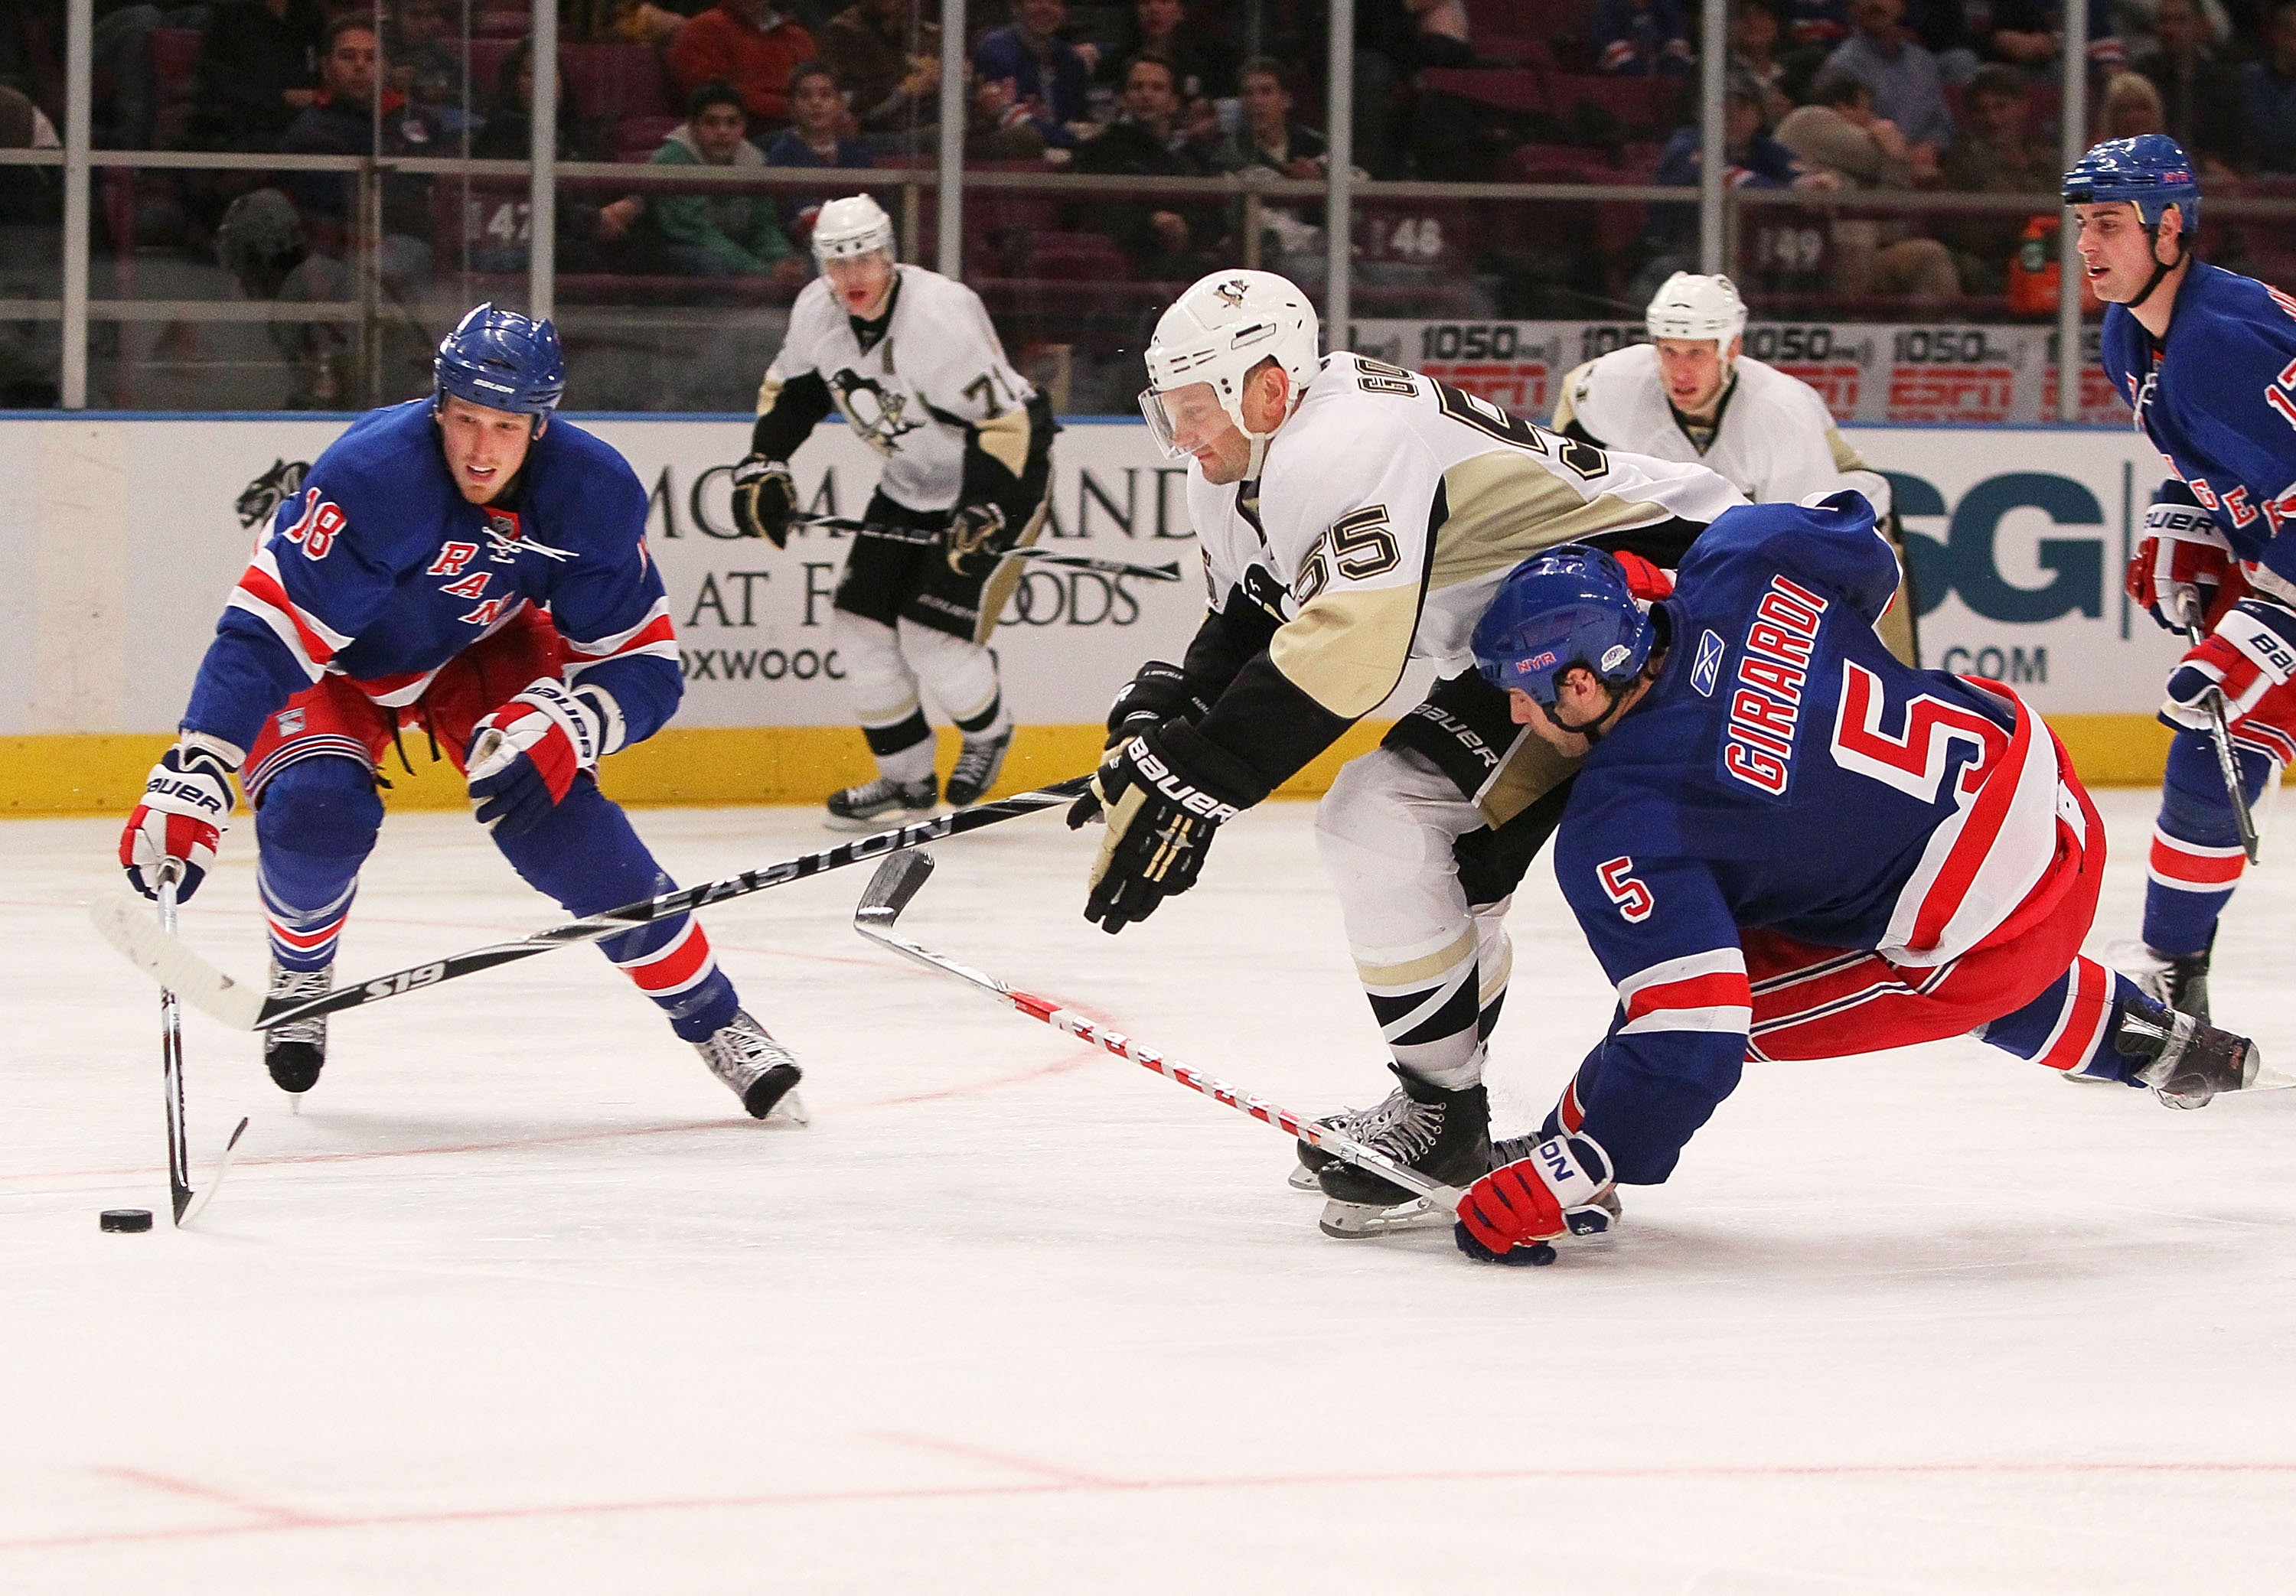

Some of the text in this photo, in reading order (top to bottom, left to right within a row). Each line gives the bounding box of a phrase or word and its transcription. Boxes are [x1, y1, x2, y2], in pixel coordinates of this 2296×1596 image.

[1421, 325, 1518, 360] 1050
[1893, 331, 1986, 362] 1050
[1888, 367, 2013, 407] ESPN
[282, 487, 347, 562] 18
[683, 571, 770, 627] AT
[1515, 651, 1557, 674] NYR
[1724, 574, 1829, 796] GIRARDI
[1411, 703, 1500, 768] BAUER
[1829, 657, 2016, 810] 5
[1127, 735, 1240, 824] BAUER
[652, 813, 954, 920] EASTON
[1595, 855, 1655, 924] 5
[363, 961, 445, 1003] S19
[1539, 1141, 1575, 1183] ON
